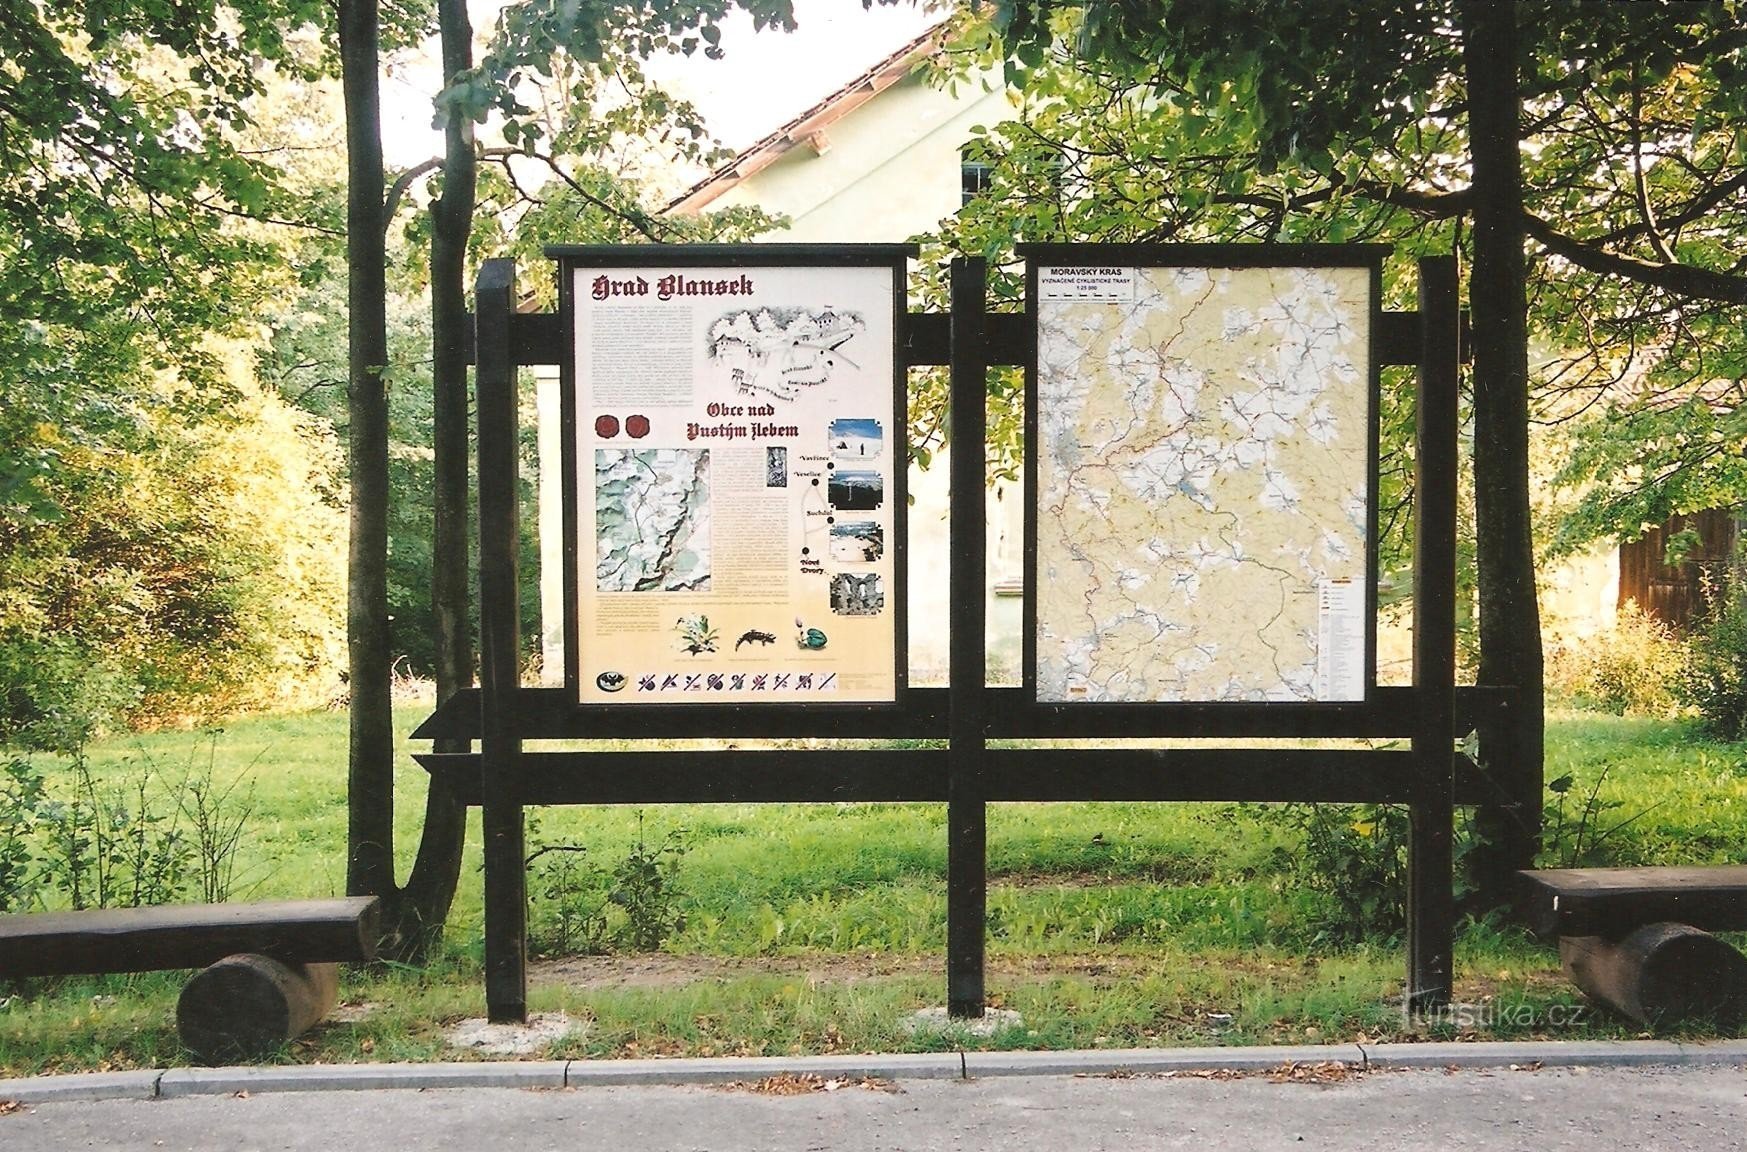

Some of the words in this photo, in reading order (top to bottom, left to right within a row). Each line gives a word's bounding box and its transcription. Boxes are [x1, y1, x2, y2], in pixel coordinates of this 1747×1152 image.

[1099, 268, 1122, 276] KRAS
[591, 274, 649, 301] Hrad
[657, 274, 754, 301] Blansek
[706, 402, 744, 417] Obce
[747, 402, 775, 417] nad
[687, 422, 747, 441] Pustým
